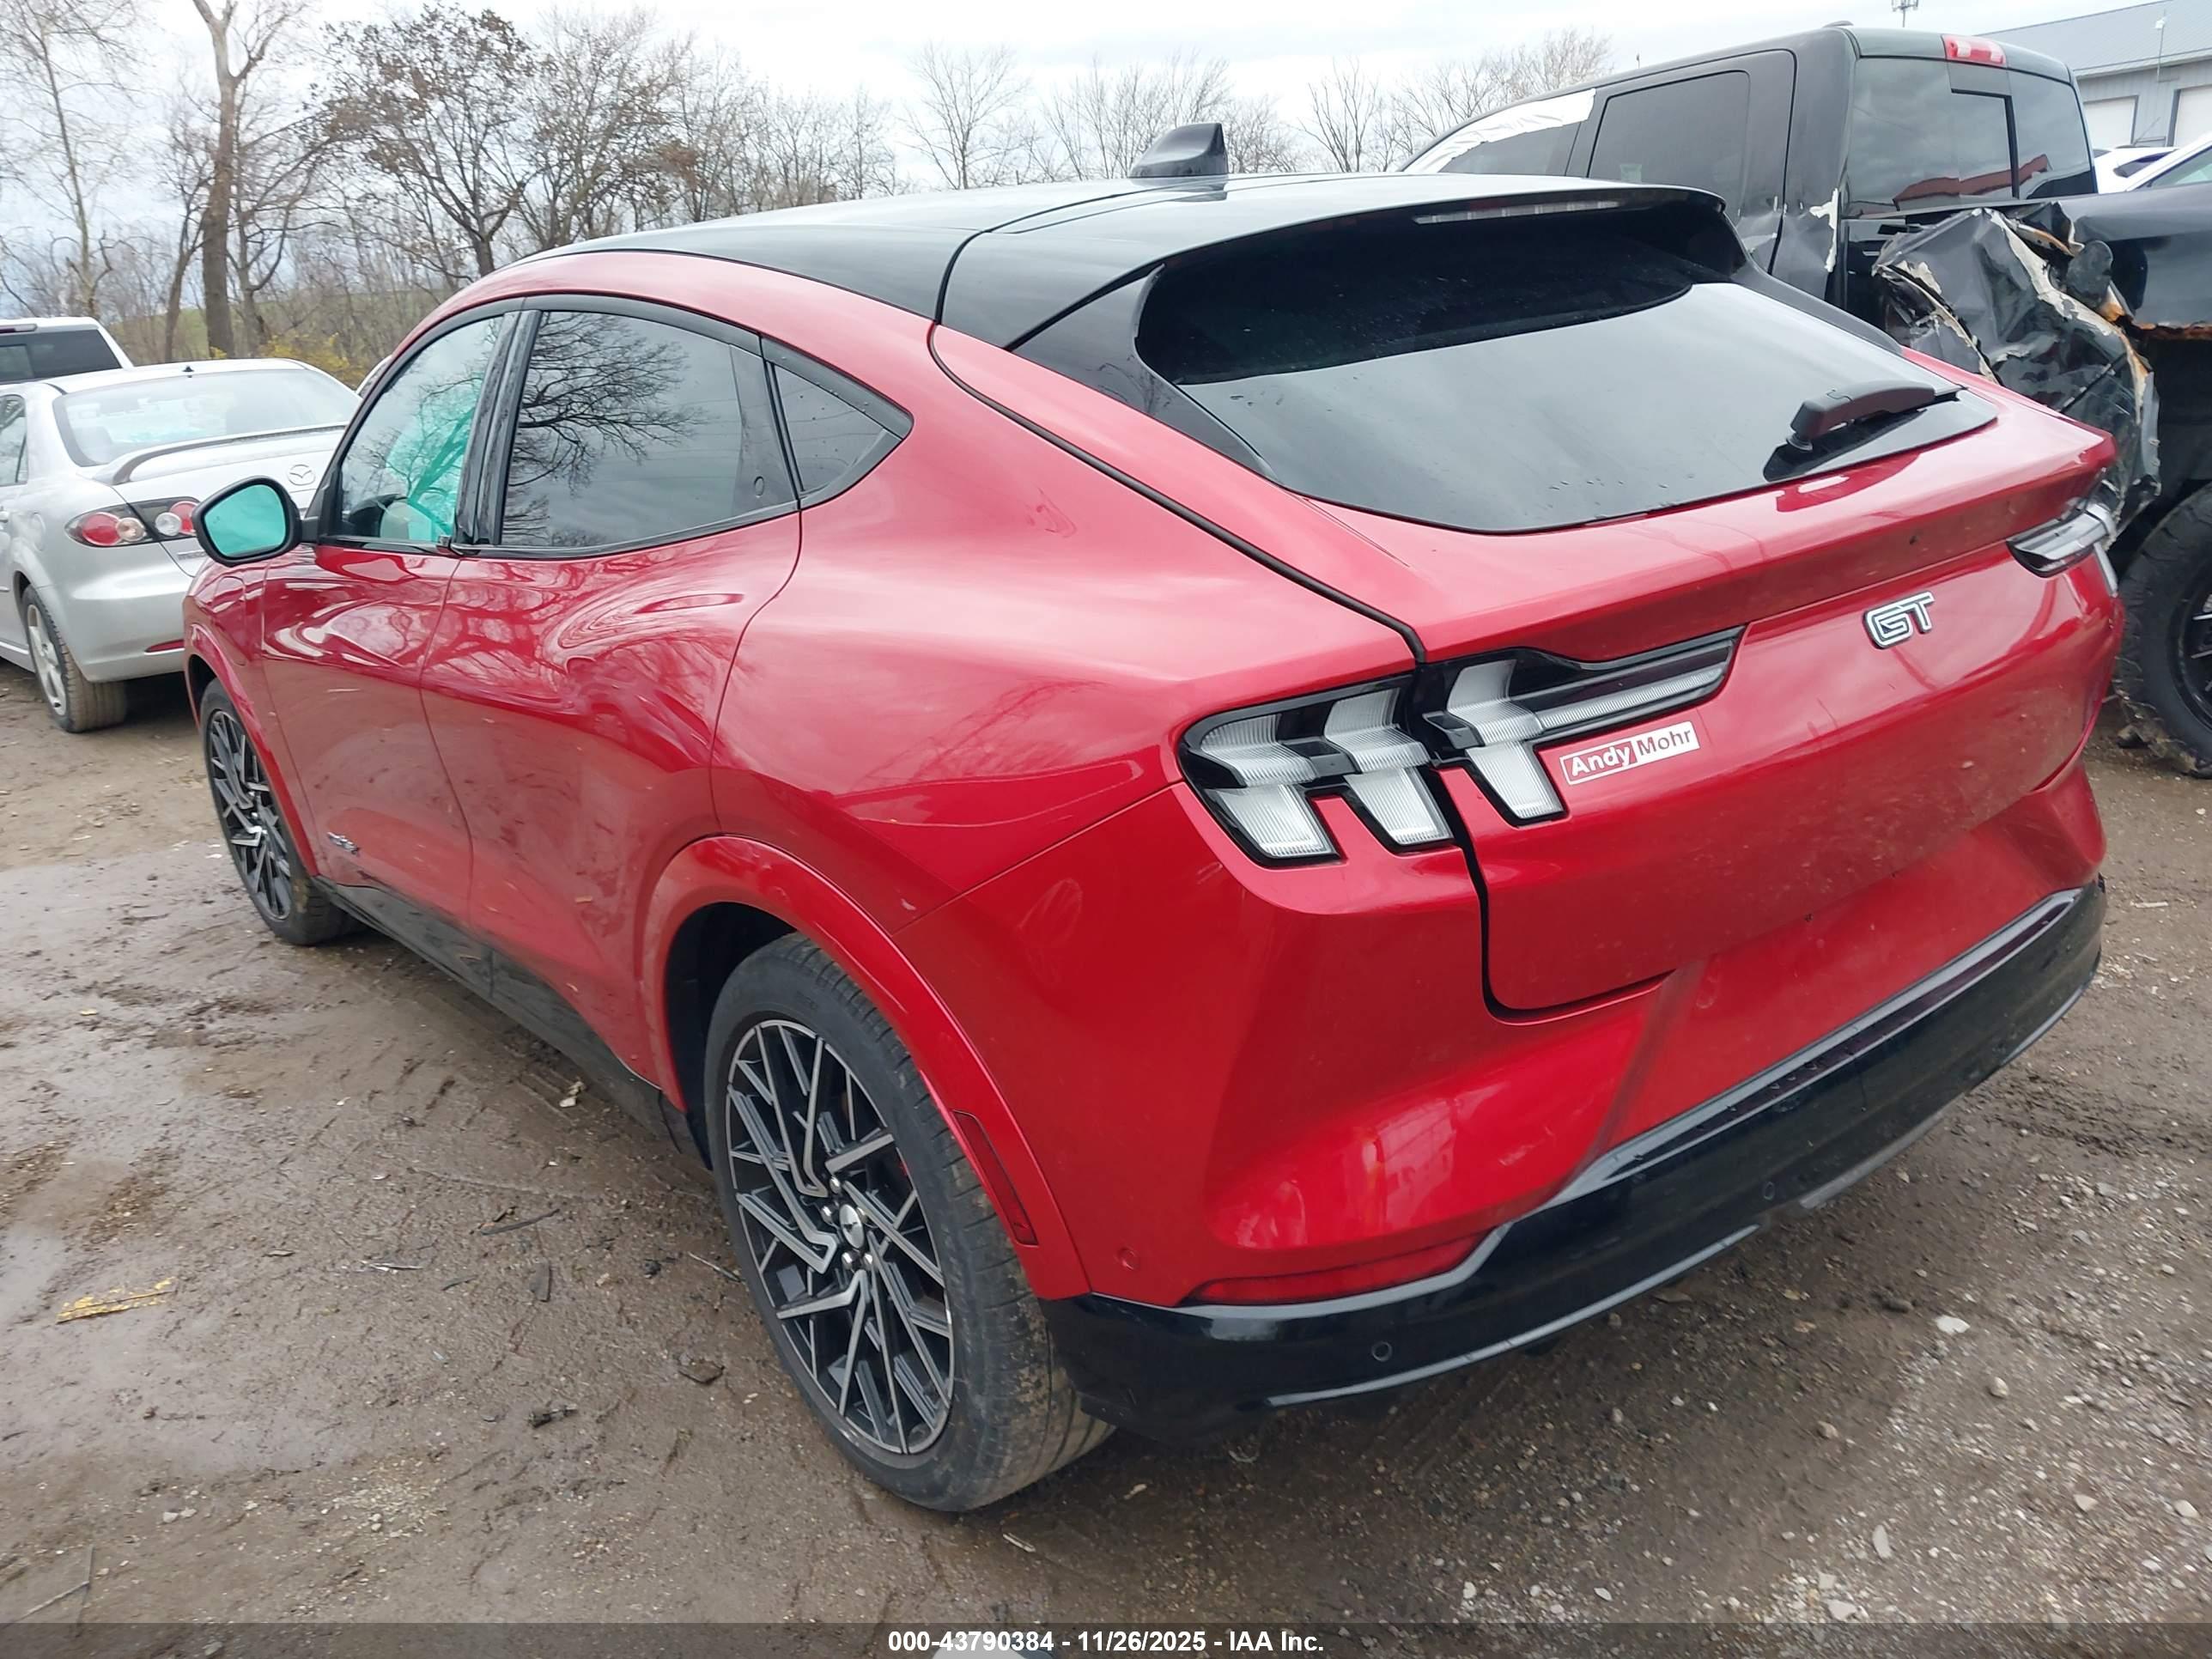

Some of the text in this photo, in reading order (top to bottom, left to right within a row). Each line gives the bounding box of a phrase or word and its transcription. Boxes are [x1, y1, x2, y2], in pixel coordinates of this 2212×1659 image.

[1863, 591, 1936, 650] GT
[1571, 729, 1691, 777] Andy Mohr
